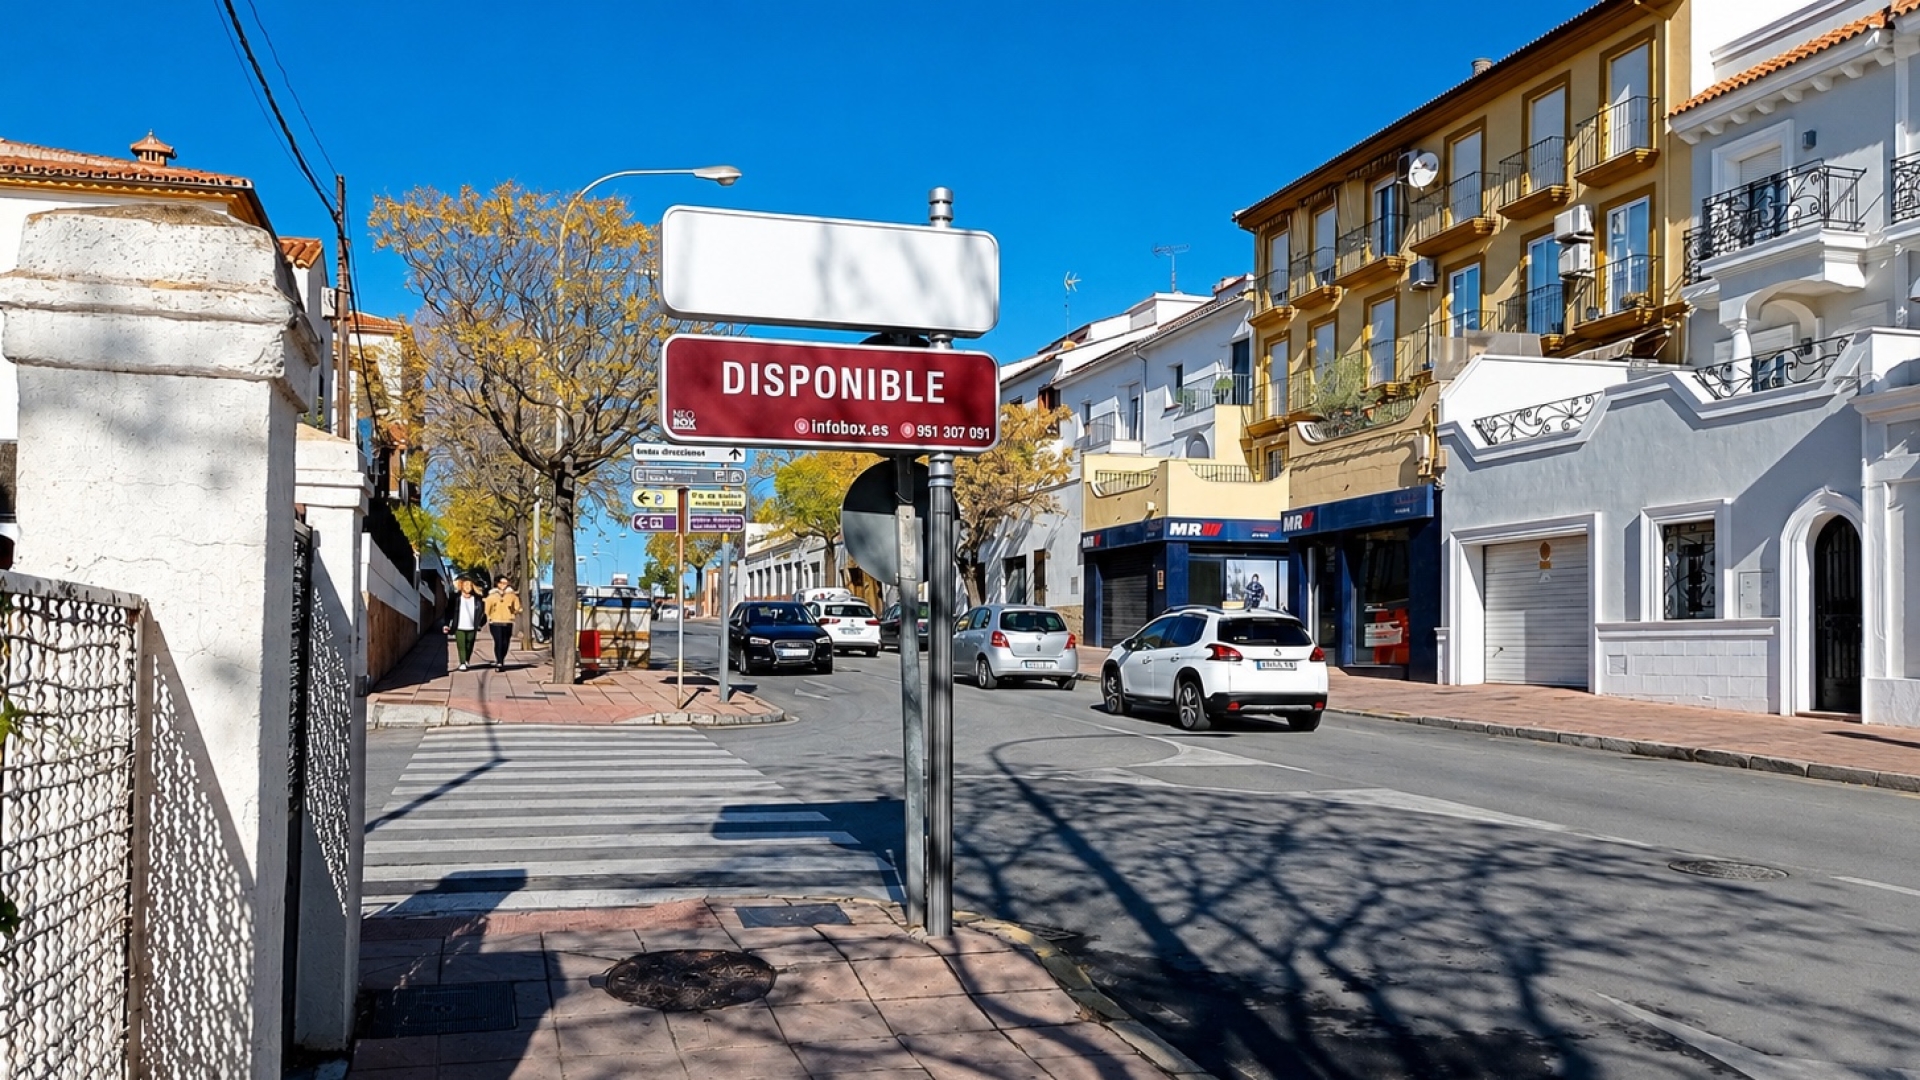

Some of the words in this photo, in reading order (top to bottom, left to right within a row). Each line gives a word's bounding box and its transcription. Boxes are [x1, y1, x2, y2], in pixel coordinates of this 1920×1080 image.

[722, 361, 945, 404] DISPONIBLE
[811, 419, 889, 437] infobox.es
[917, 424, 938, 438] 951
[943, 425, 965, 439] 307
[969, 427, 990, 440] 091
[1169, 522, 1223, 537] MRW
